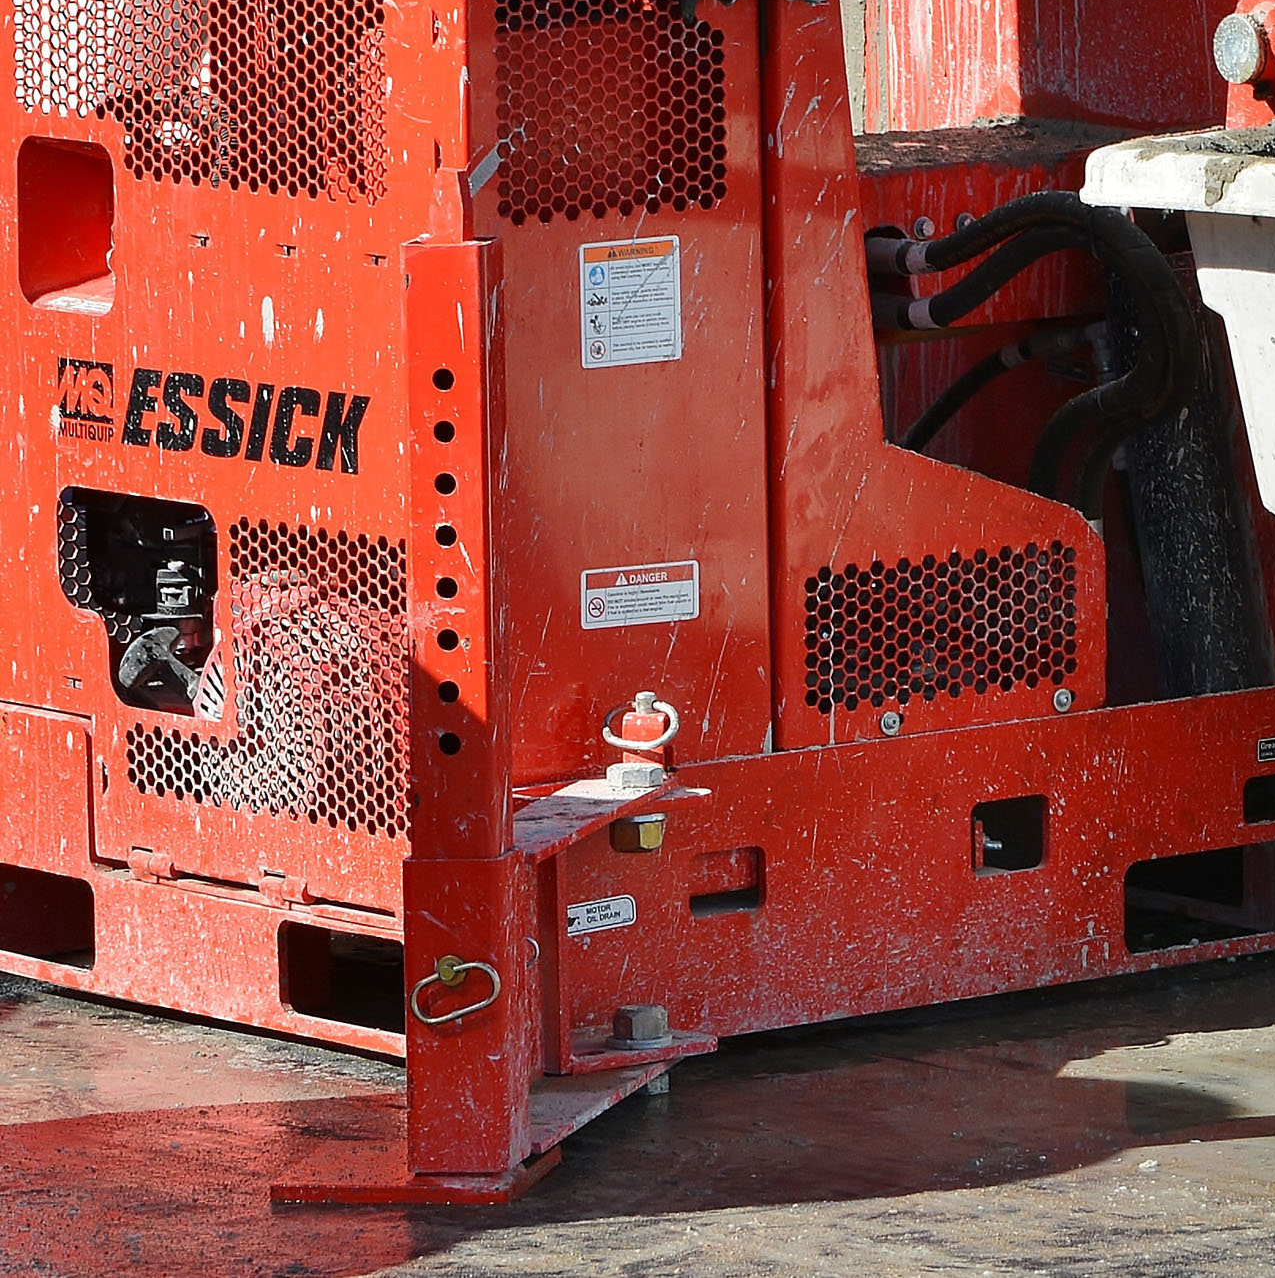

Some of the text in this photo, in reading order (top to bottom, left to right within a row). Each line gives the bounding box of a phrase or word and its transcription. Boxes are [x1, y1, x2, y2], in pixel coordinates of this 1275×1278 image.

[617, 246, 655, 259] WARNING
[120, 367, 371, 475] ESSICK
[57, 418, 114, 444] MULTIQUIP
[629, 571, 668, 584] DANGER
[585, 903, 612, 915] MOTOR
[586, 910, 621, 924] OIL DRAIN
